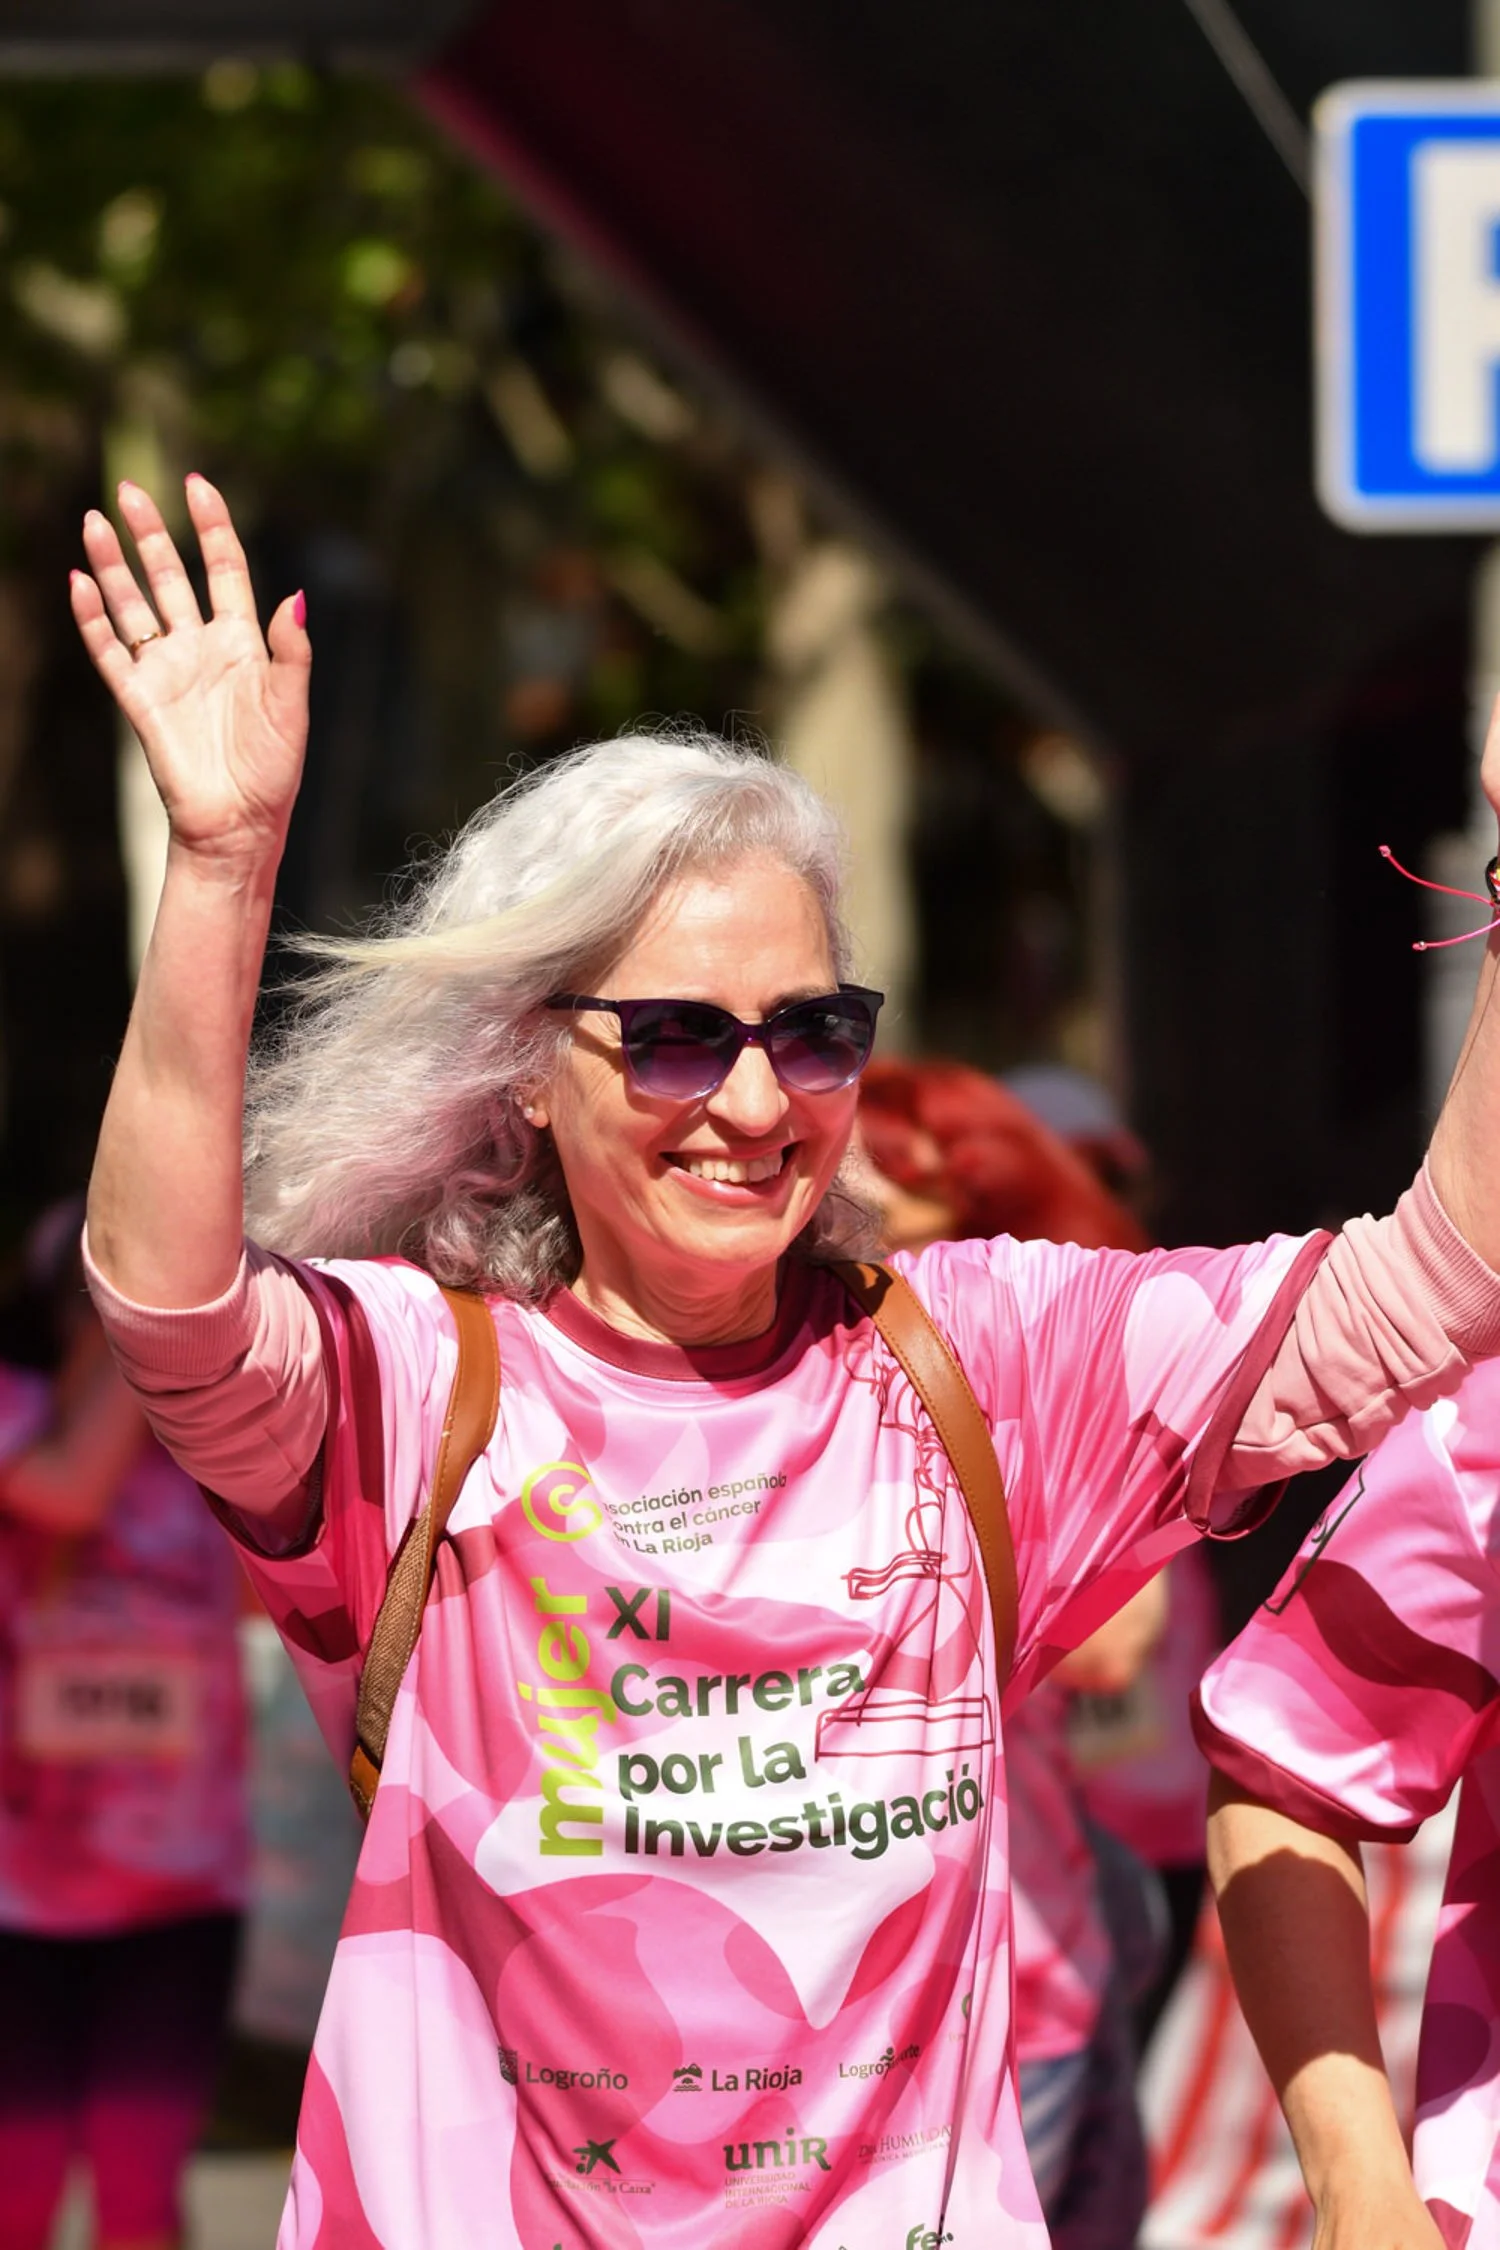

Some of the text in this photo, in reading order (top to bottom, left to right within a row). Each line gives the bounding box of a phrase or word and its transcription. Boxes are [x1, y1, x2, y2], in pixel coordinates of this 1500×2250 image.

[607, 1500, 761, 1534] ontra el cáncer
[635, 1539, 658, 1555] La
[662, 1533, 713, 1554] Rioja
[604, 1587, 671, 1641] XI
[610, 1662, 865, 1718] Carrera
[518, 1577, 618, 1856] mujer
[618, 1736, 806, 1802] por la
[526, 2062, 628, 2091] Logroño
[712, 2064, 802, 2092] La Rioja
